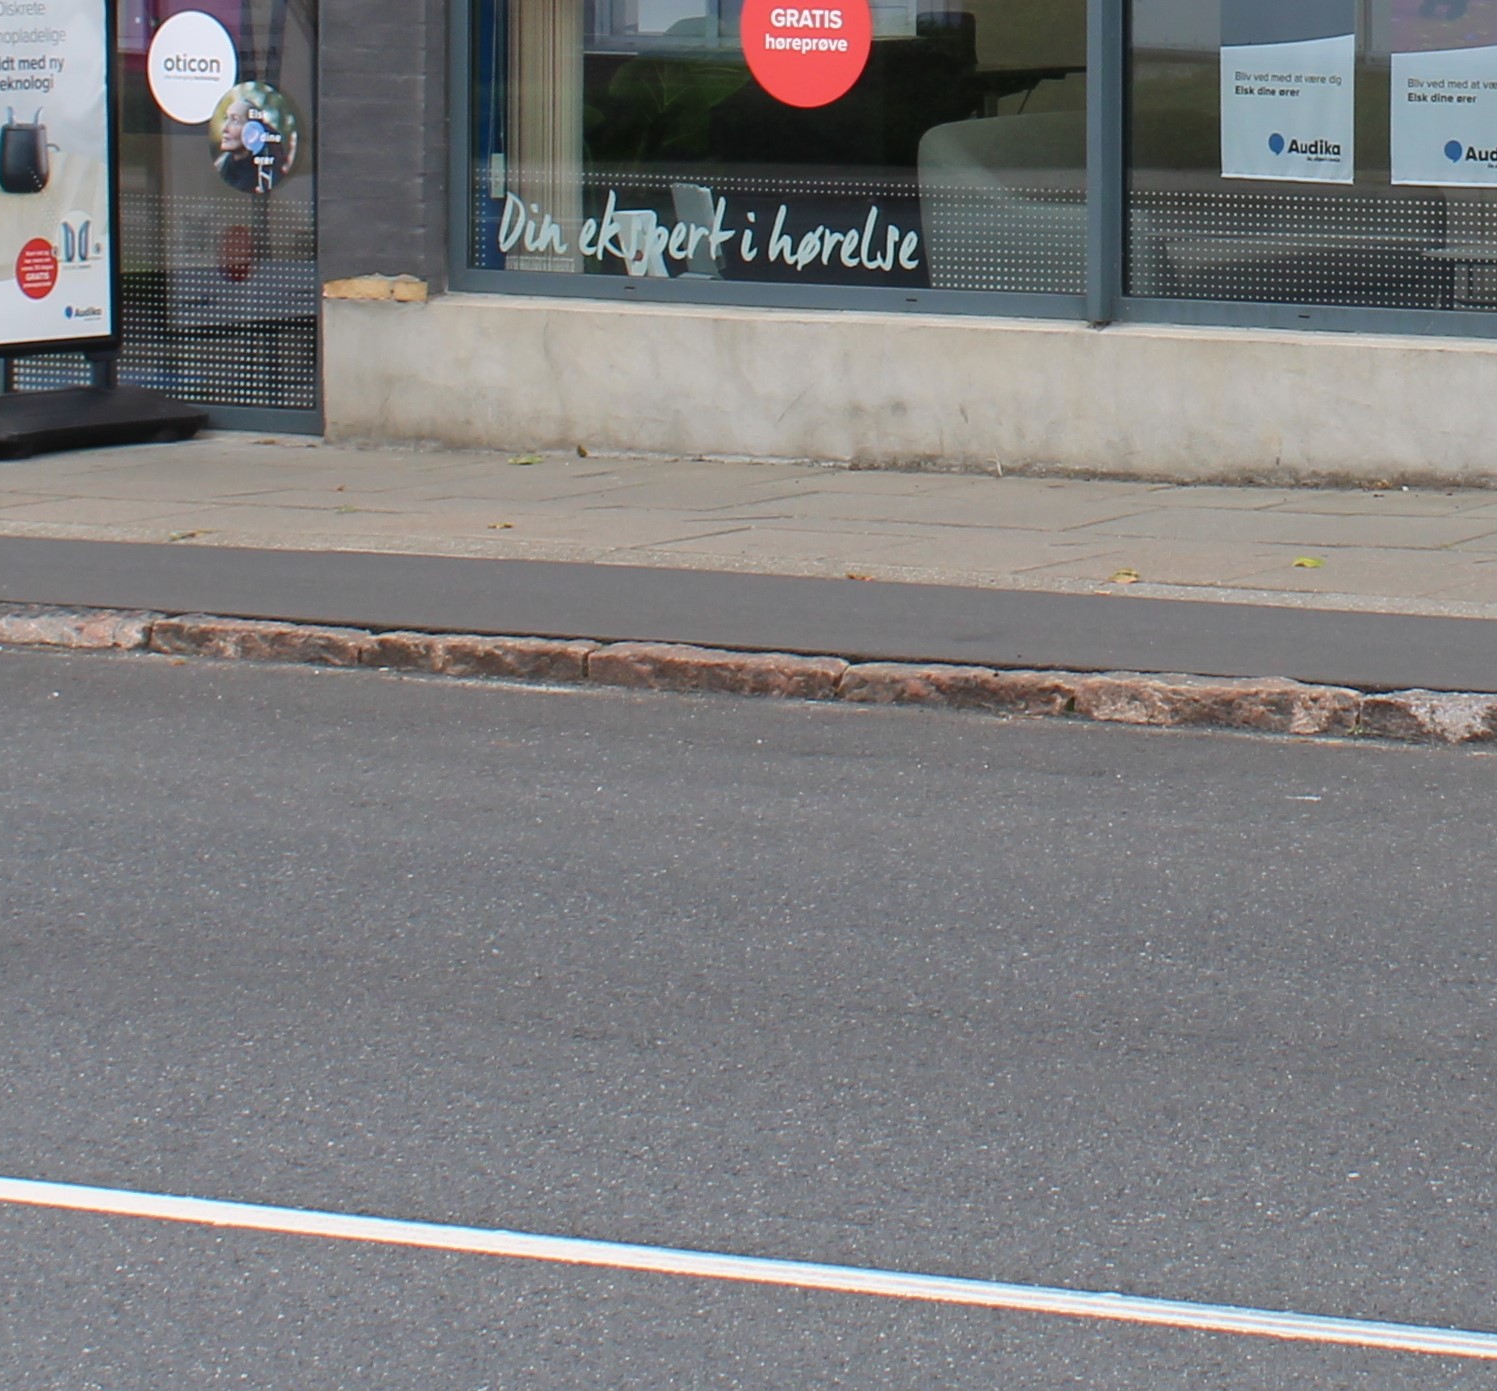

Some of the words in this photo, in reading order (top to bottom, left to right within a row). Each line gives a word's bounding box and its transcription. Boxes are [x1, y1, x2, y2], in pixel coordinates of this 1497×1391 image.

[770, 8, 843, 29] GRATIS
[765, 33, 848, 54] høreprøve
[18, 56, 46, 70] med
[49, 58, 64, 73] ny
[163, 54, 221, 73] oticon
[1408, 78, 1425, 88] Bliv
[1427, 80, 1444, 89] ved
[1448, 80, 1468, 89] med
[1471, 81, 1480, 89] at
[1408, 93, 1428, 102] Elsk
[1431, 93, 1454, 103] dine
[1287, 139, 1341, 155] Audika
[497, 191, 569, 256] Din
[578, 189, 735, 277] ekspert
[740, 211, 757, 262] i
[768, 204, 919, 271] hørelse
[75, 307, 102, 317] Audika
